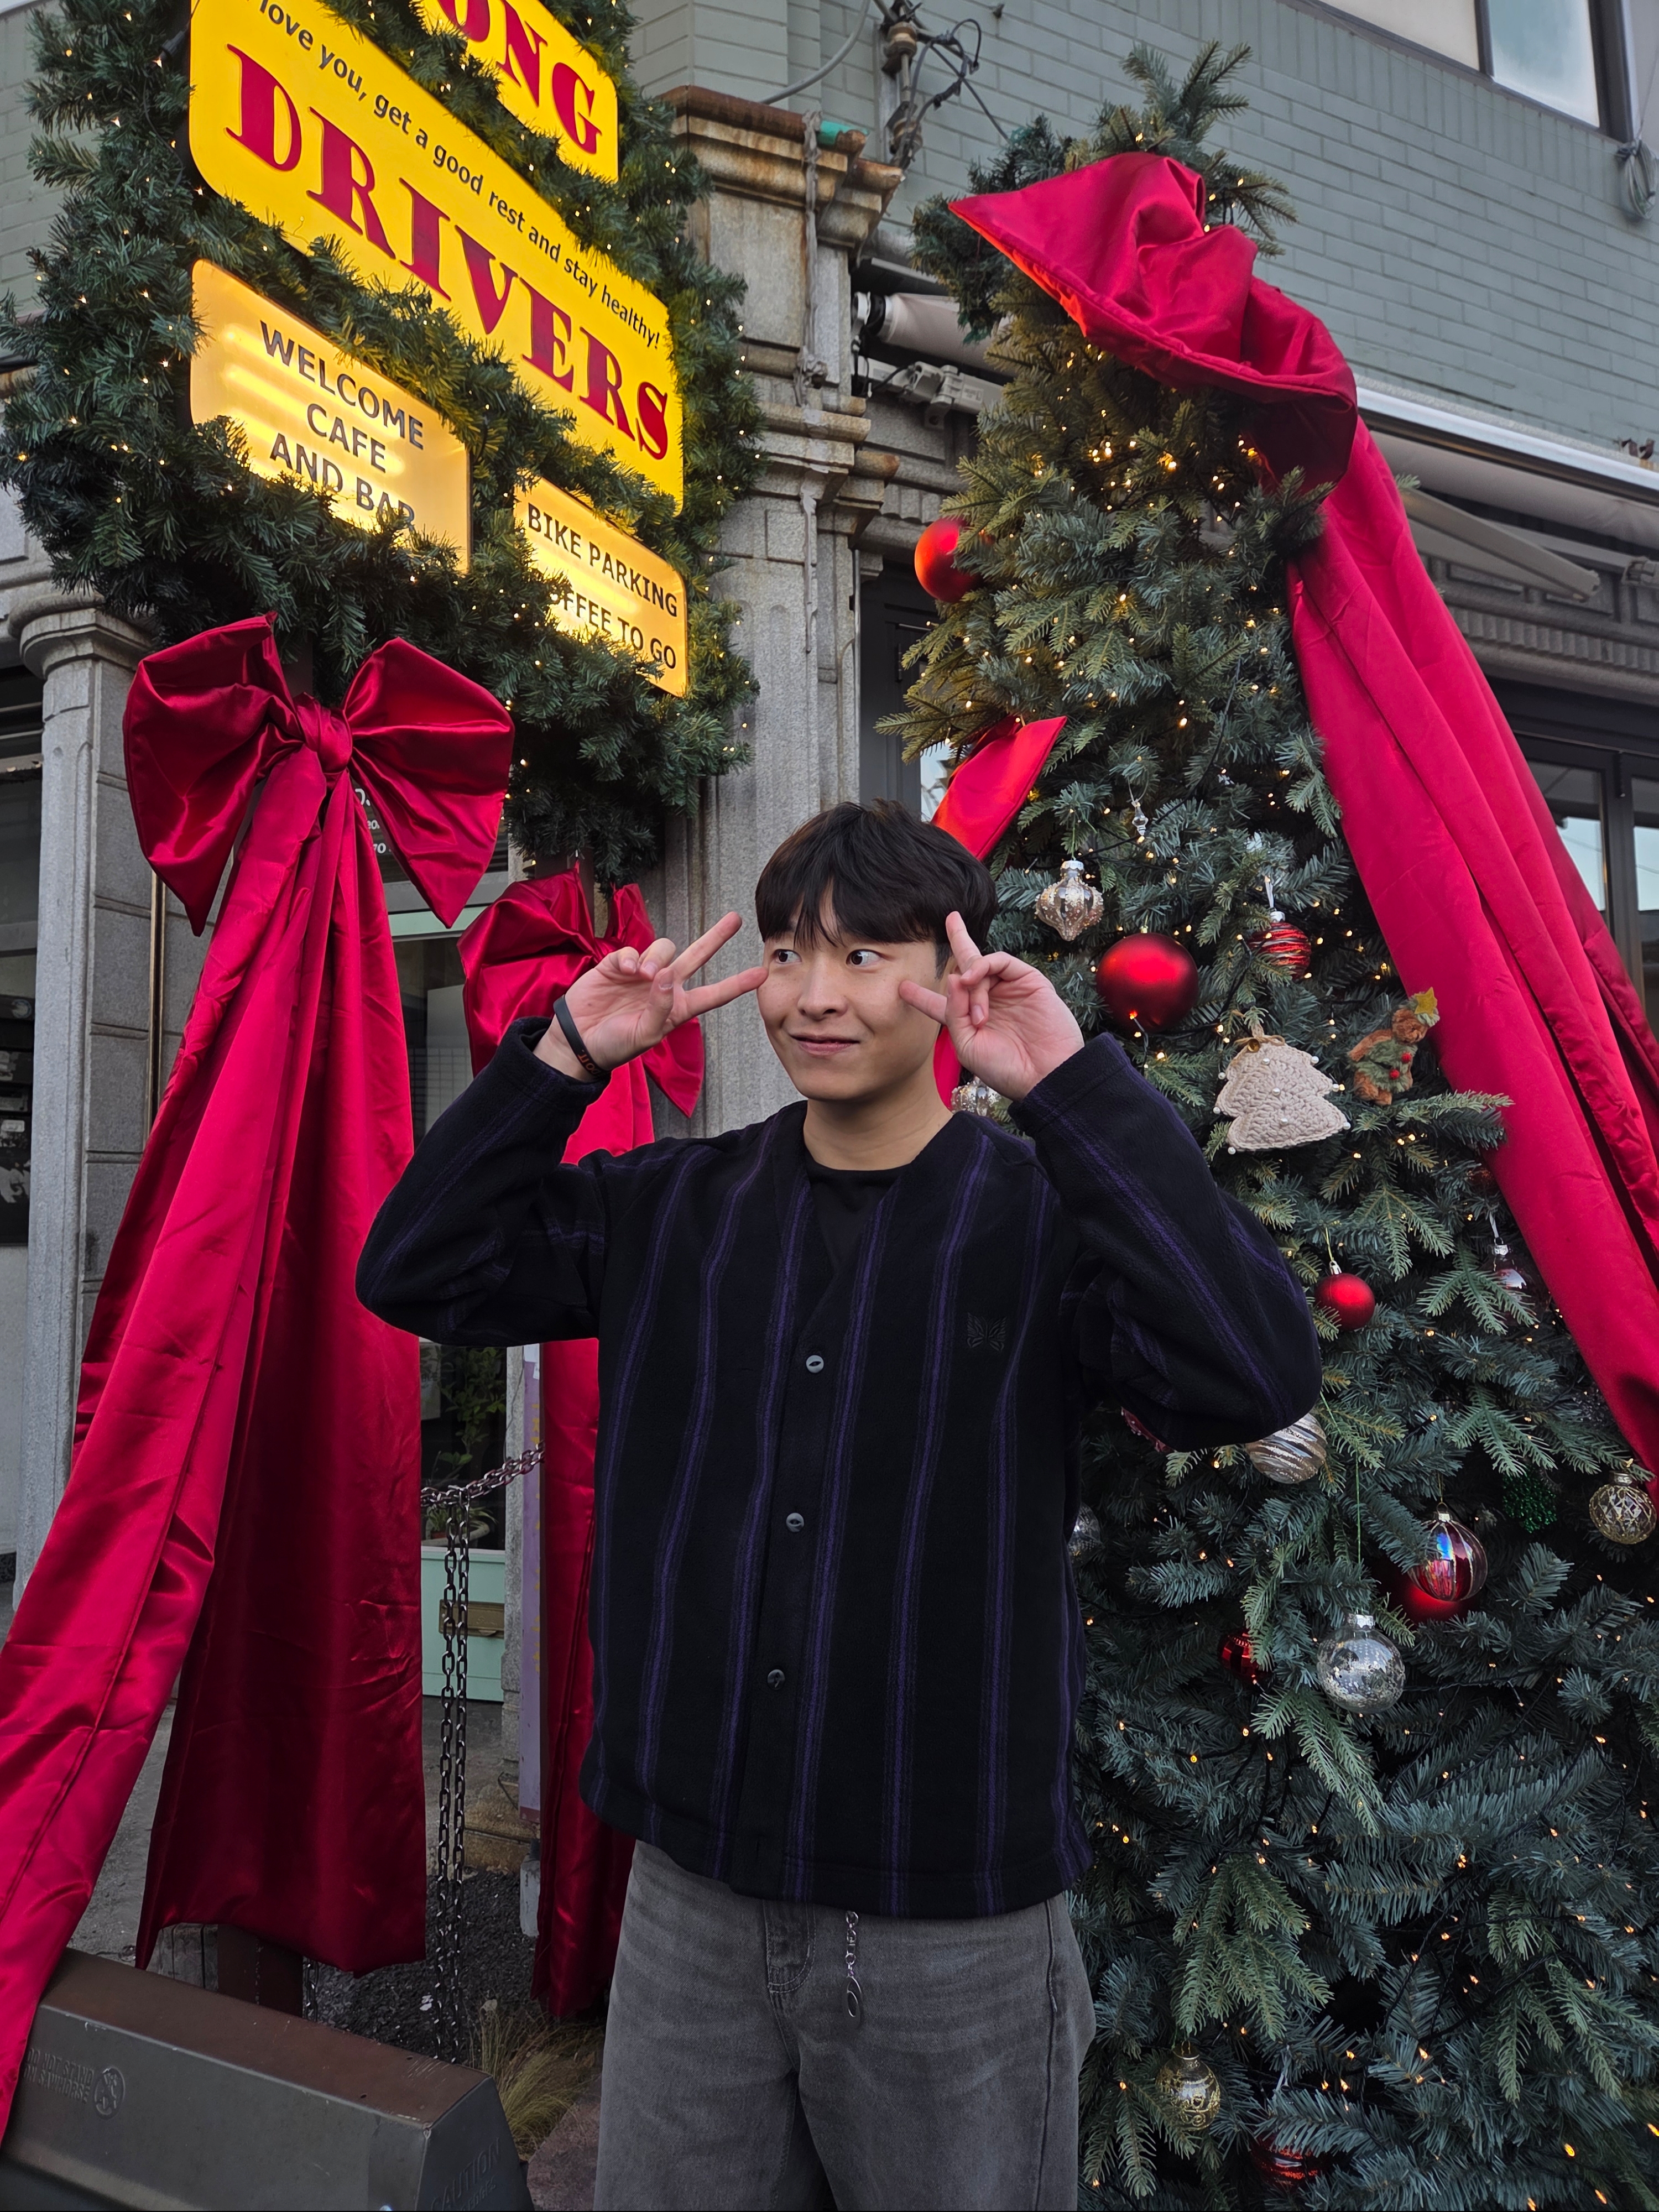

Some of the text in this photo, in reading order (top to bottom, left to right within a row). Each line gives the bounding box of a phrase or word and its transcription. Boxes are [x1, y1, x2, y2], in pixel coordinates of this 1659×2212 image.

[319, 44, 366, 101] you,
[374, 95, 411, 134] get
[415, 128, 428, 149] a
[432, 144, 483, 195] good
[489, 191, 525, 232] rest
[528, 226, 561, 263] and
[564, 257, 598, 297] stay
[601, 285, 660, 348] healthy!
[225, 44, 668, 460] DRIVERS
[260, 320, 424, 450] WELCOME
[270, 432, 415, 532] AND BAR
[307, 403, 386, 473] CAFE
[528, 502, 677, 617] BIKE PARKING
[563, 591, 676, 669] FFEE TO GO
[586, 1063, 601, 1074] DO
[28, 2047, 95, 2085] DO NOT STAND
[431, 2136, 499, 2212] CAUTION
